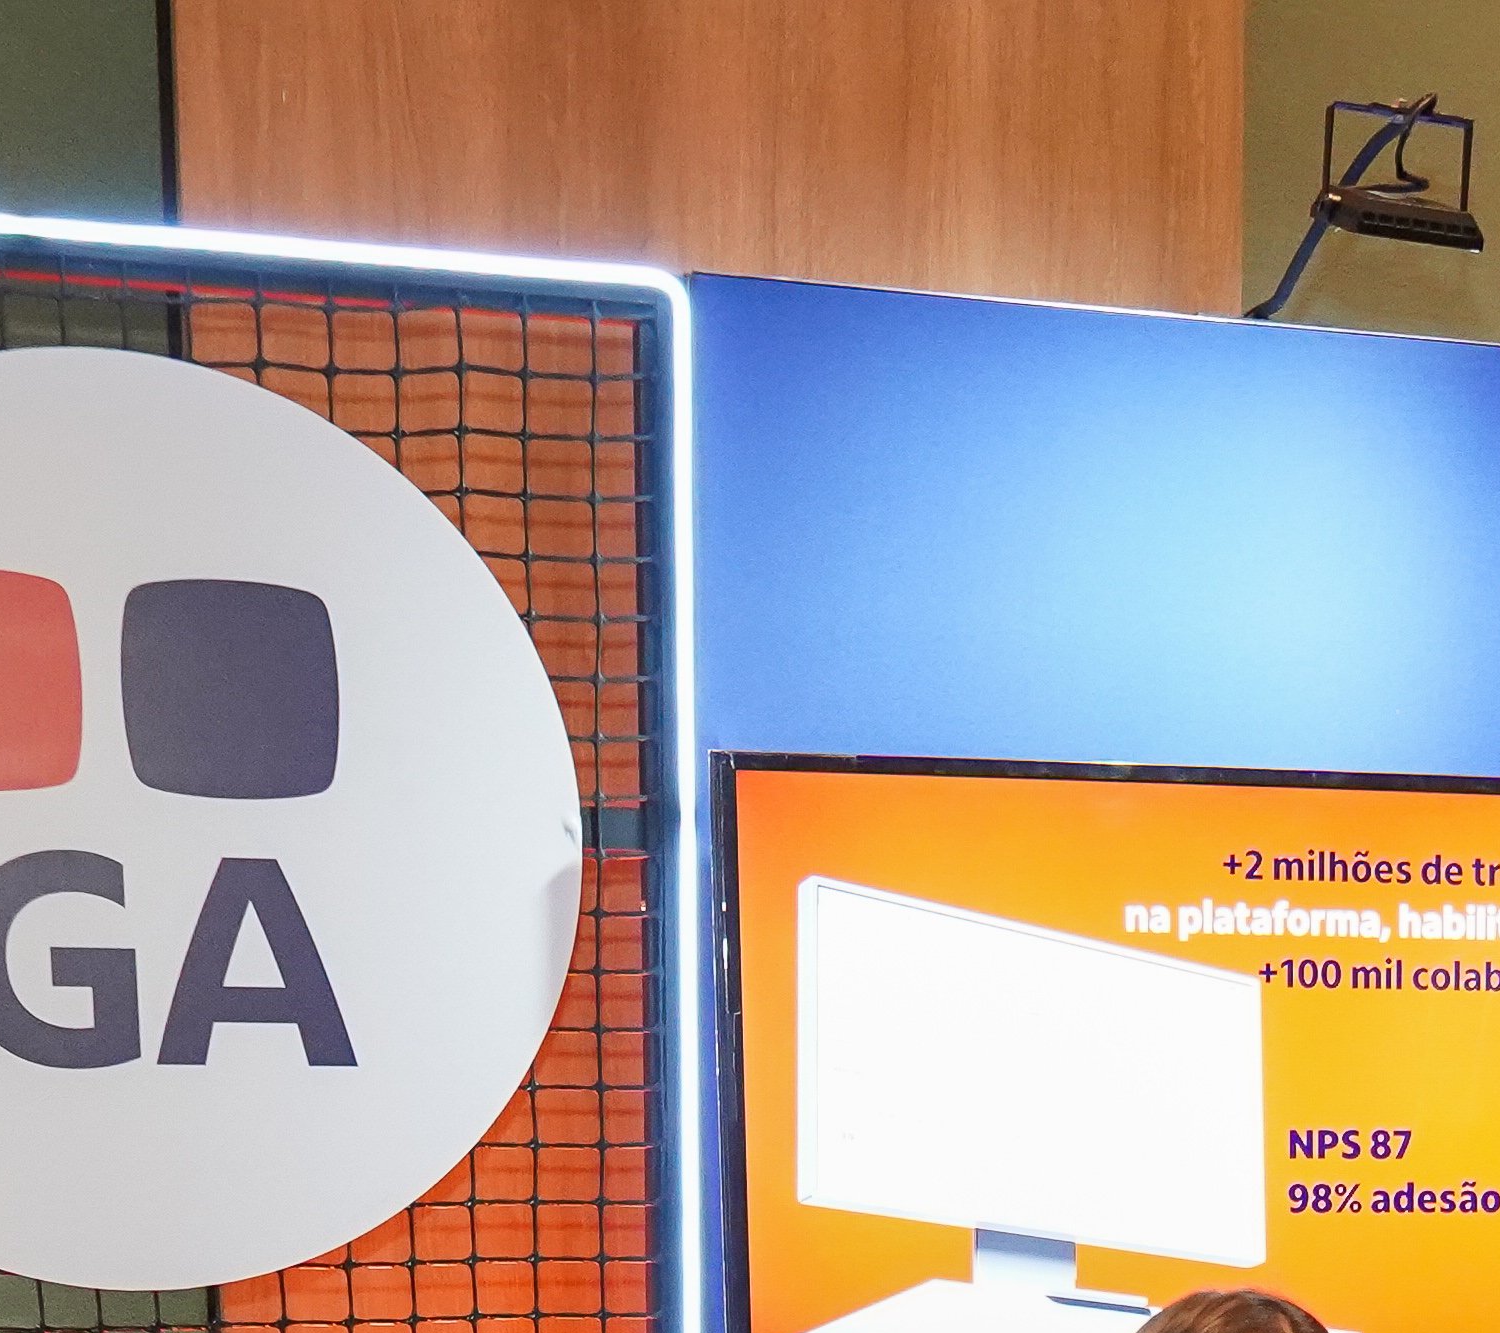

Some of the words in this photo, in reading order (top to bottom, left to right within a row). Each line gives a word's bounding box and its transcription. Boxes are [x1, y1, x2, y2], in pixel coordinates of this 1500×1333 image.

[1223, 851, 1264, 881] +2
[1272, 849, 1412, 886] milhões
[1421, 855, 1464, 887] de
[1124, 902, 1171, 935] na
[1178, 899, 1391, 943] plataforma,
[1258, 959, 1342, 990] +100
[1351, 959, 1404, 991] mil
[1288, 1129, 1362, 1160] NPS
[1370, 1130, 1413, 1160] 87
[1288, 1183, 1362, 1215] 98%
